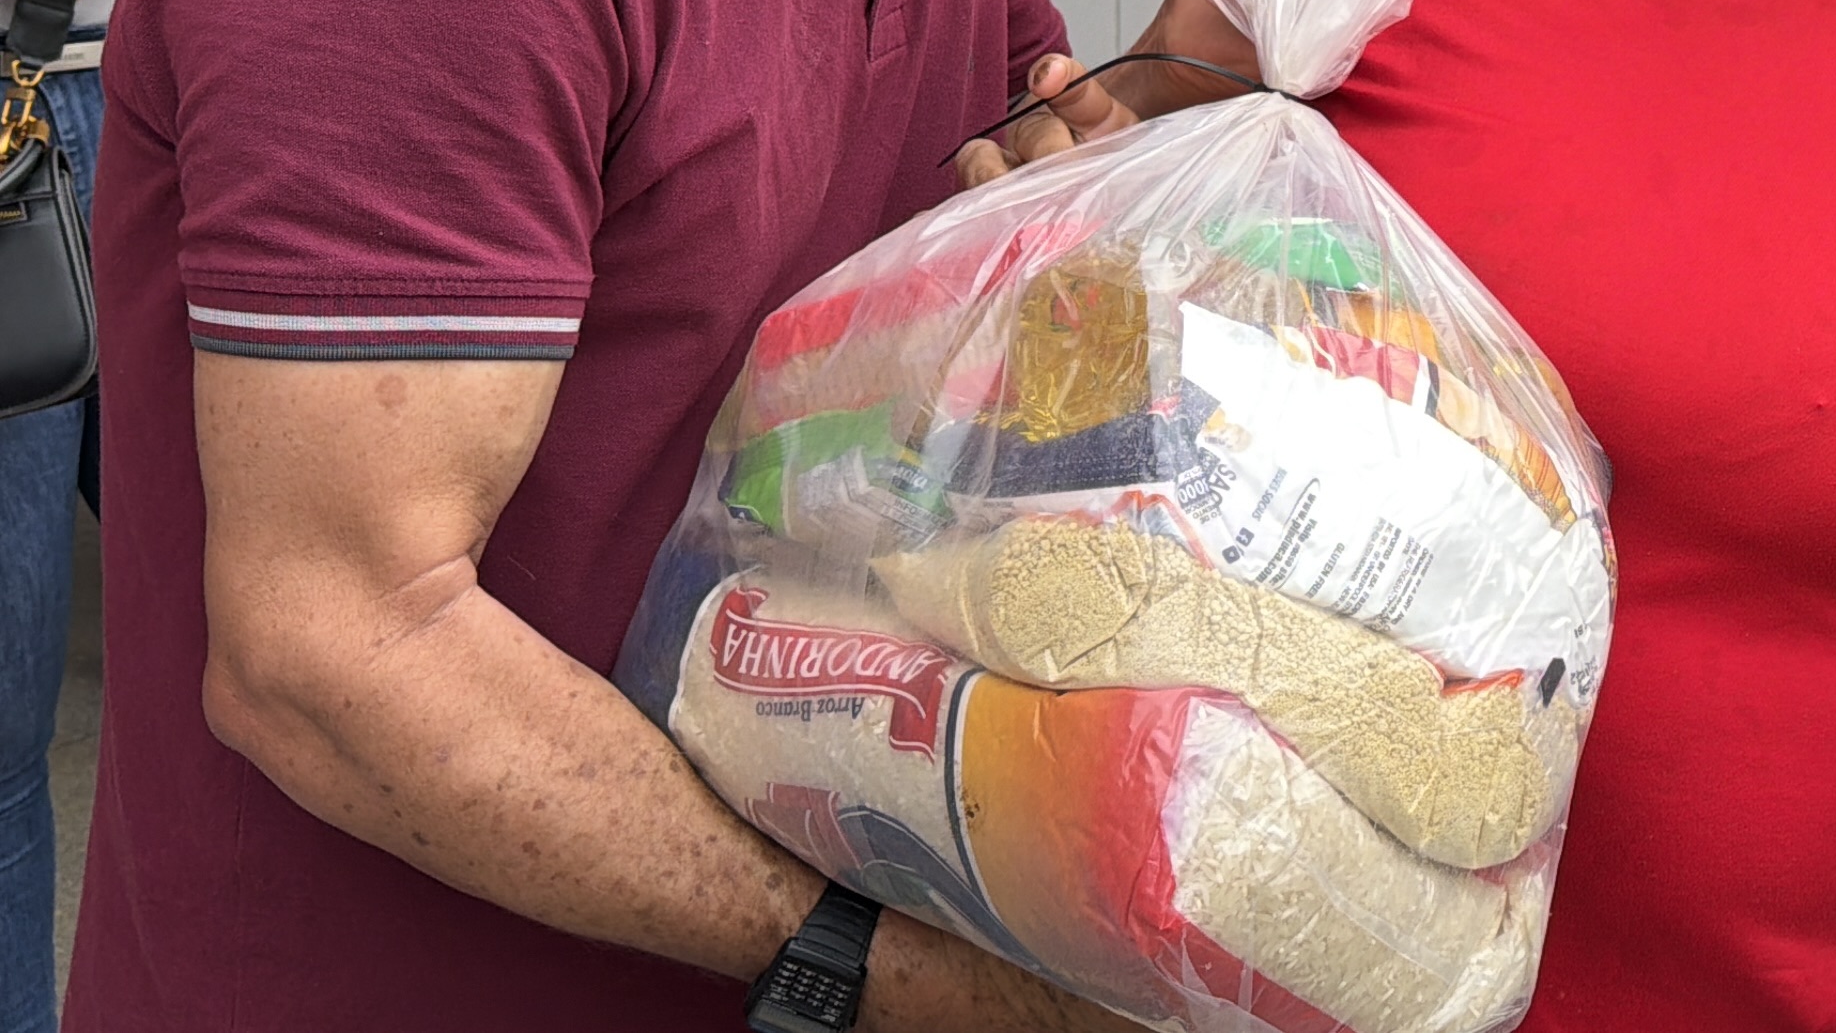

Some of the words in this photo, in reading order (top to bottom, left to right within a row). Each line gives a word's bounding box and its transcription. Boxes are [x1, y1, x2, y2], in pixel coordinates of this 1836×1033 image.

[1297, 518, 1318, 543] Visite
[1321, 542, 1345, 578] GLUTEN
[1304, 575, 1325, 599] FREE
[722, 623, 947, 684] ANDORINHA
[755, 698, 812, 722] Branco
[816, 696, 866, 720] Arroz
